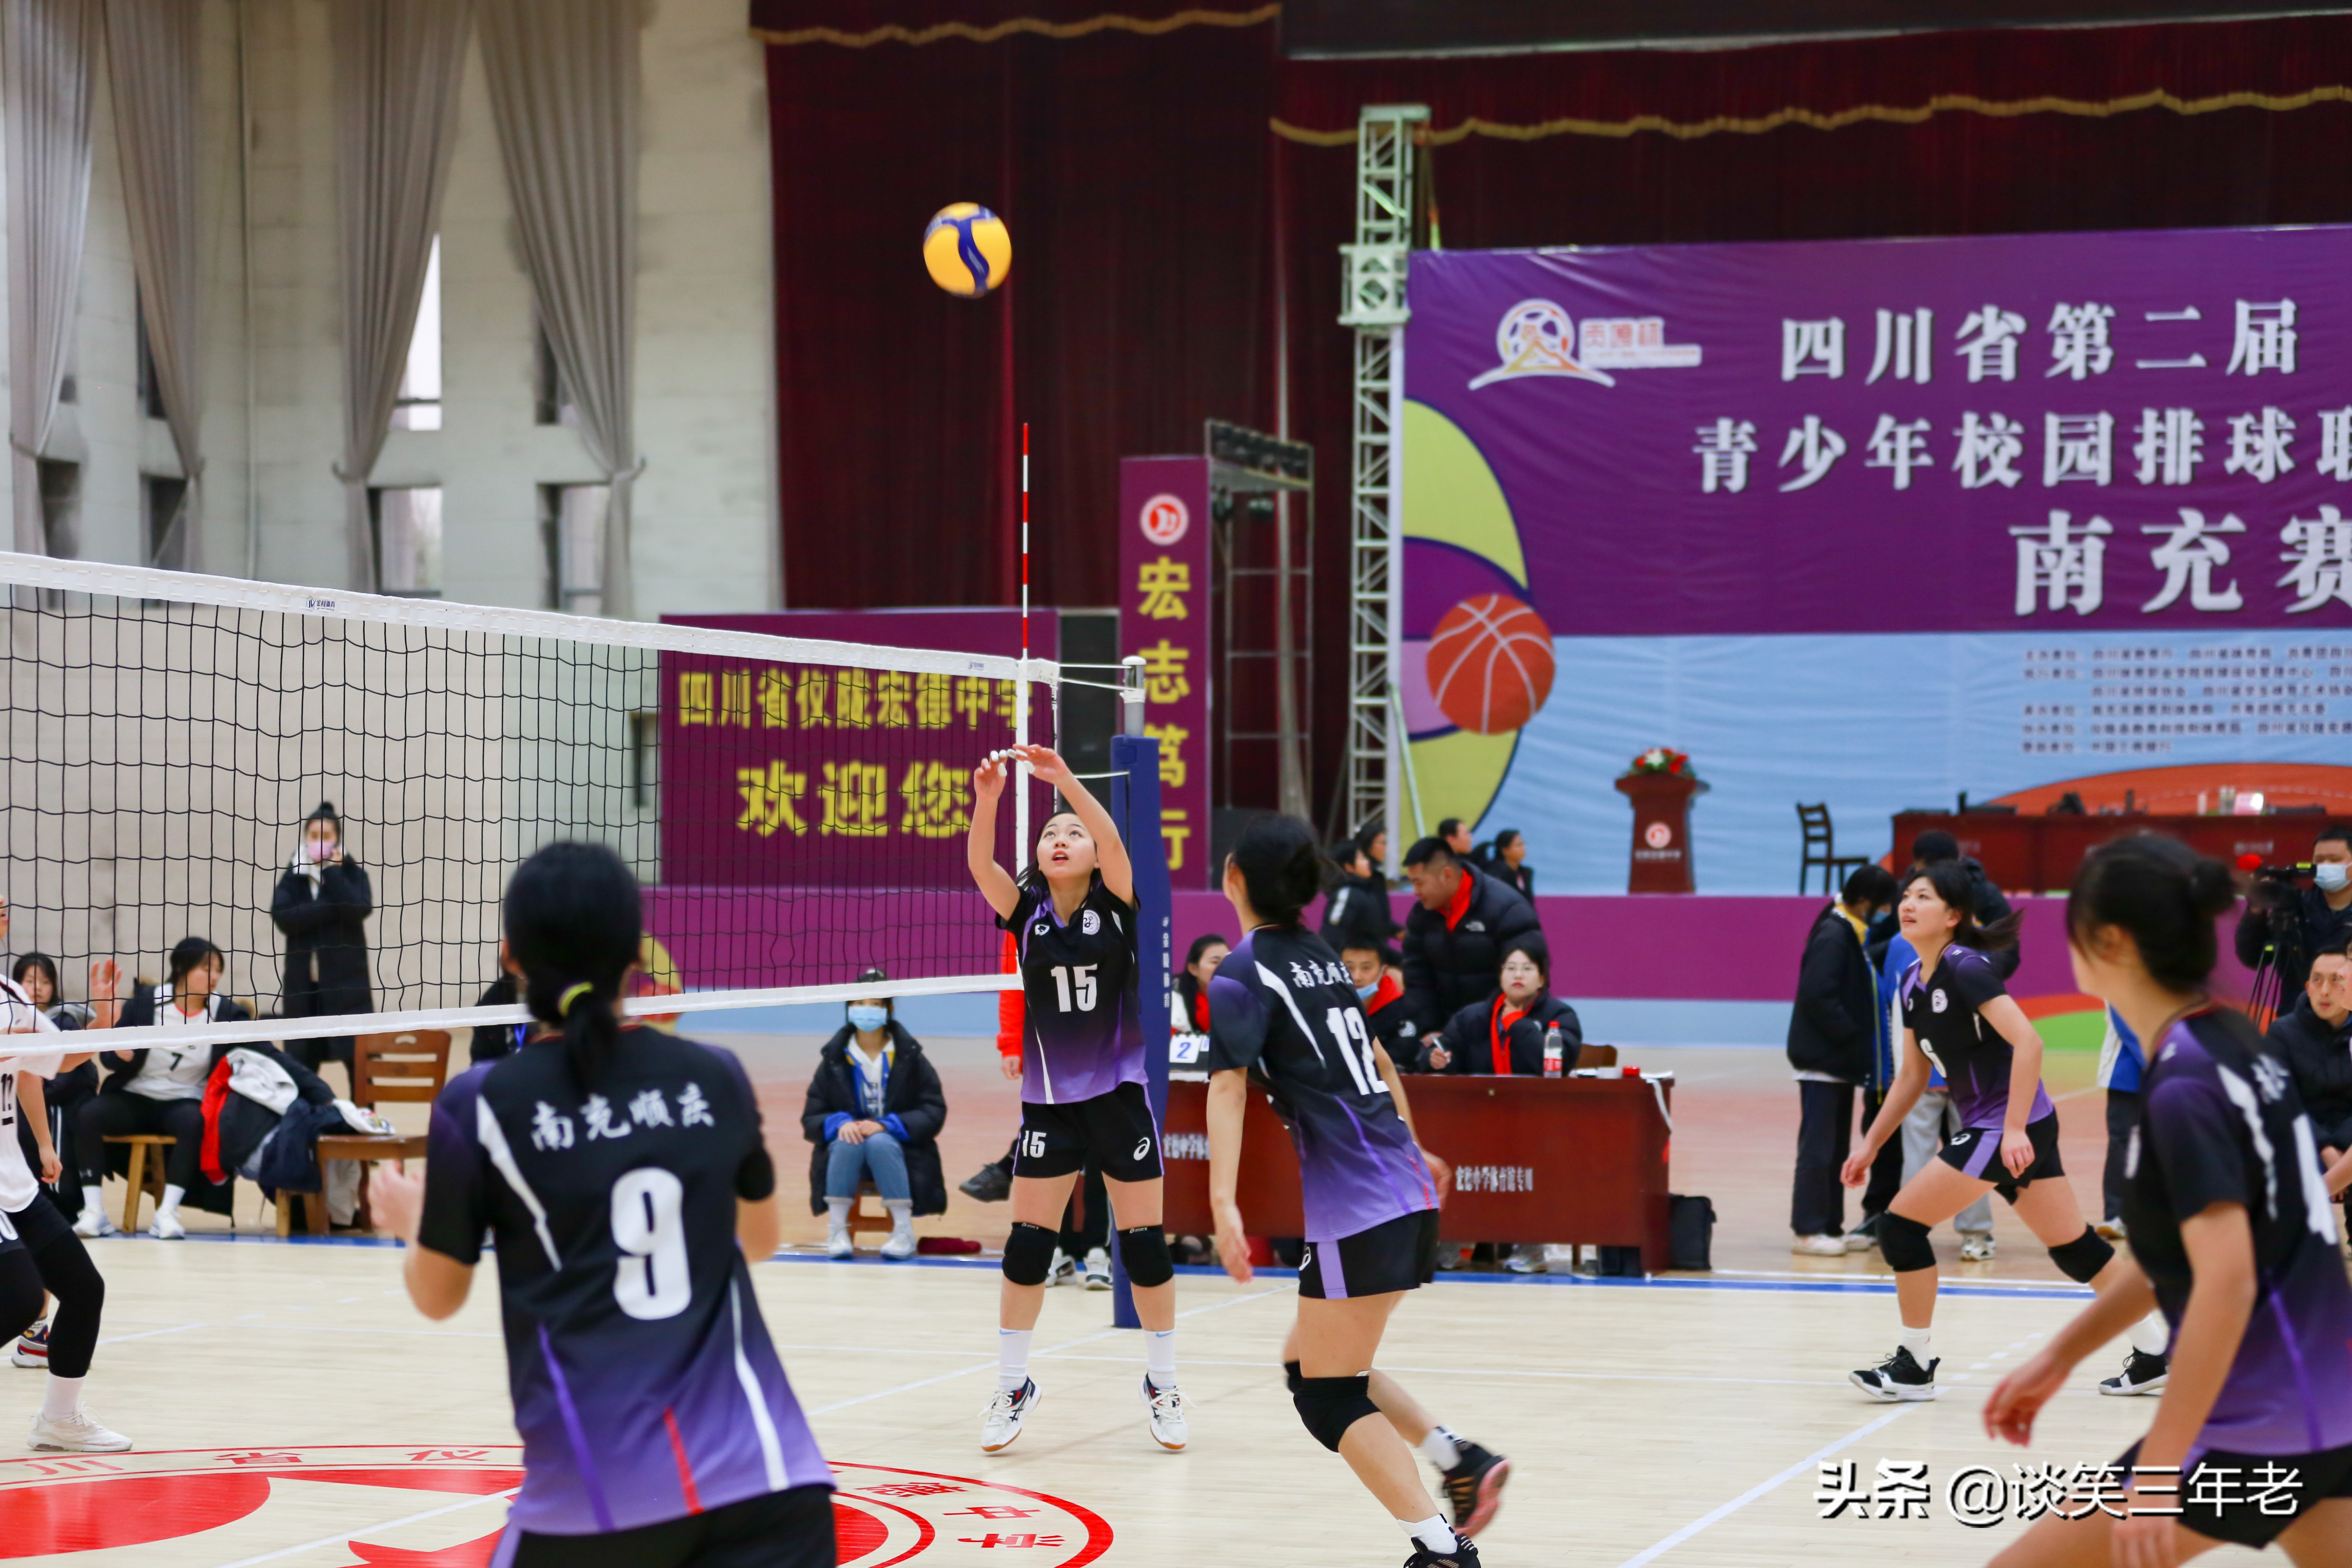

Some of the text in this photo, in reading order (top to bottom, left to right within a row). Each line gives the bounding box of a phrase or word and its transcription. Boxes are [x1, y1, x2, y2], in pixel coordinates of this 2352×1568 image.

[1781, 298, 2298, 385] 四川省第二届
[2008, 505, 2352, 616] 南充赛
[737, 760, 972, 838] 欢迎您
[1051, 963, 1098, 1013] 15
[169, 1052, 184, 1072] 7
[1176, 1042, 1192, 1059] 2
[1325, 1007, 1390, 1095] 12
[531, 1082, 715, 1151] 南充顺庆
[1022, 1130, 1047, 1158] 15
[611, 1167, 692, 1321] 9
